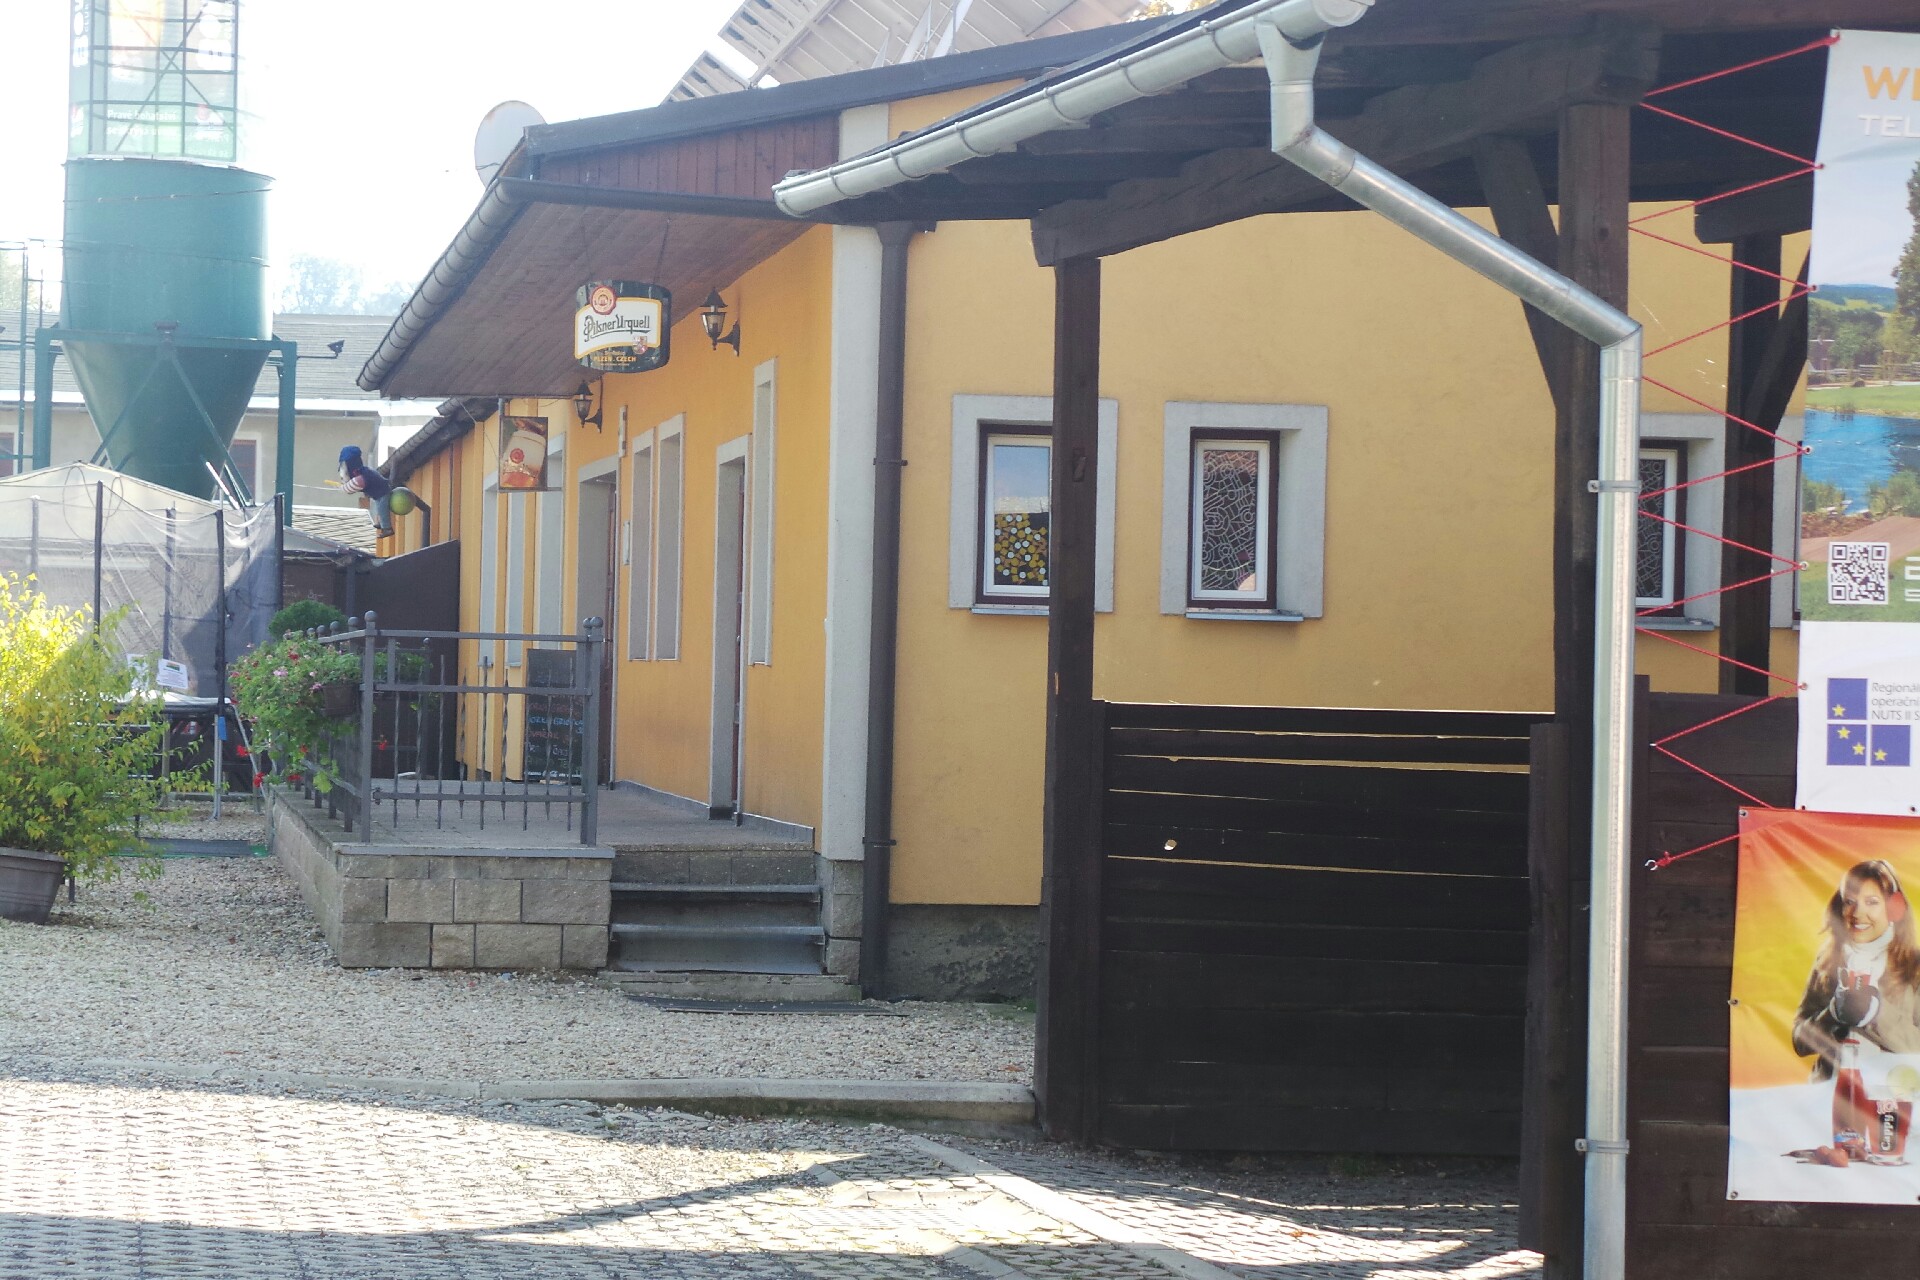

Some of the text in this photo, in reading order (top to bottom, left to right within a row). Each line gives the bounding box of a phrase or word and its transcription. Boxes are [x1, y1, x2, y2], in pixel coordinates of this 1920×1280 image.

[583, 314, 651, 342] Pilsner Urquell
[1872, 710, 1902, 721] NUTS
[1881, 1114, 1895, 1151] Cappy
